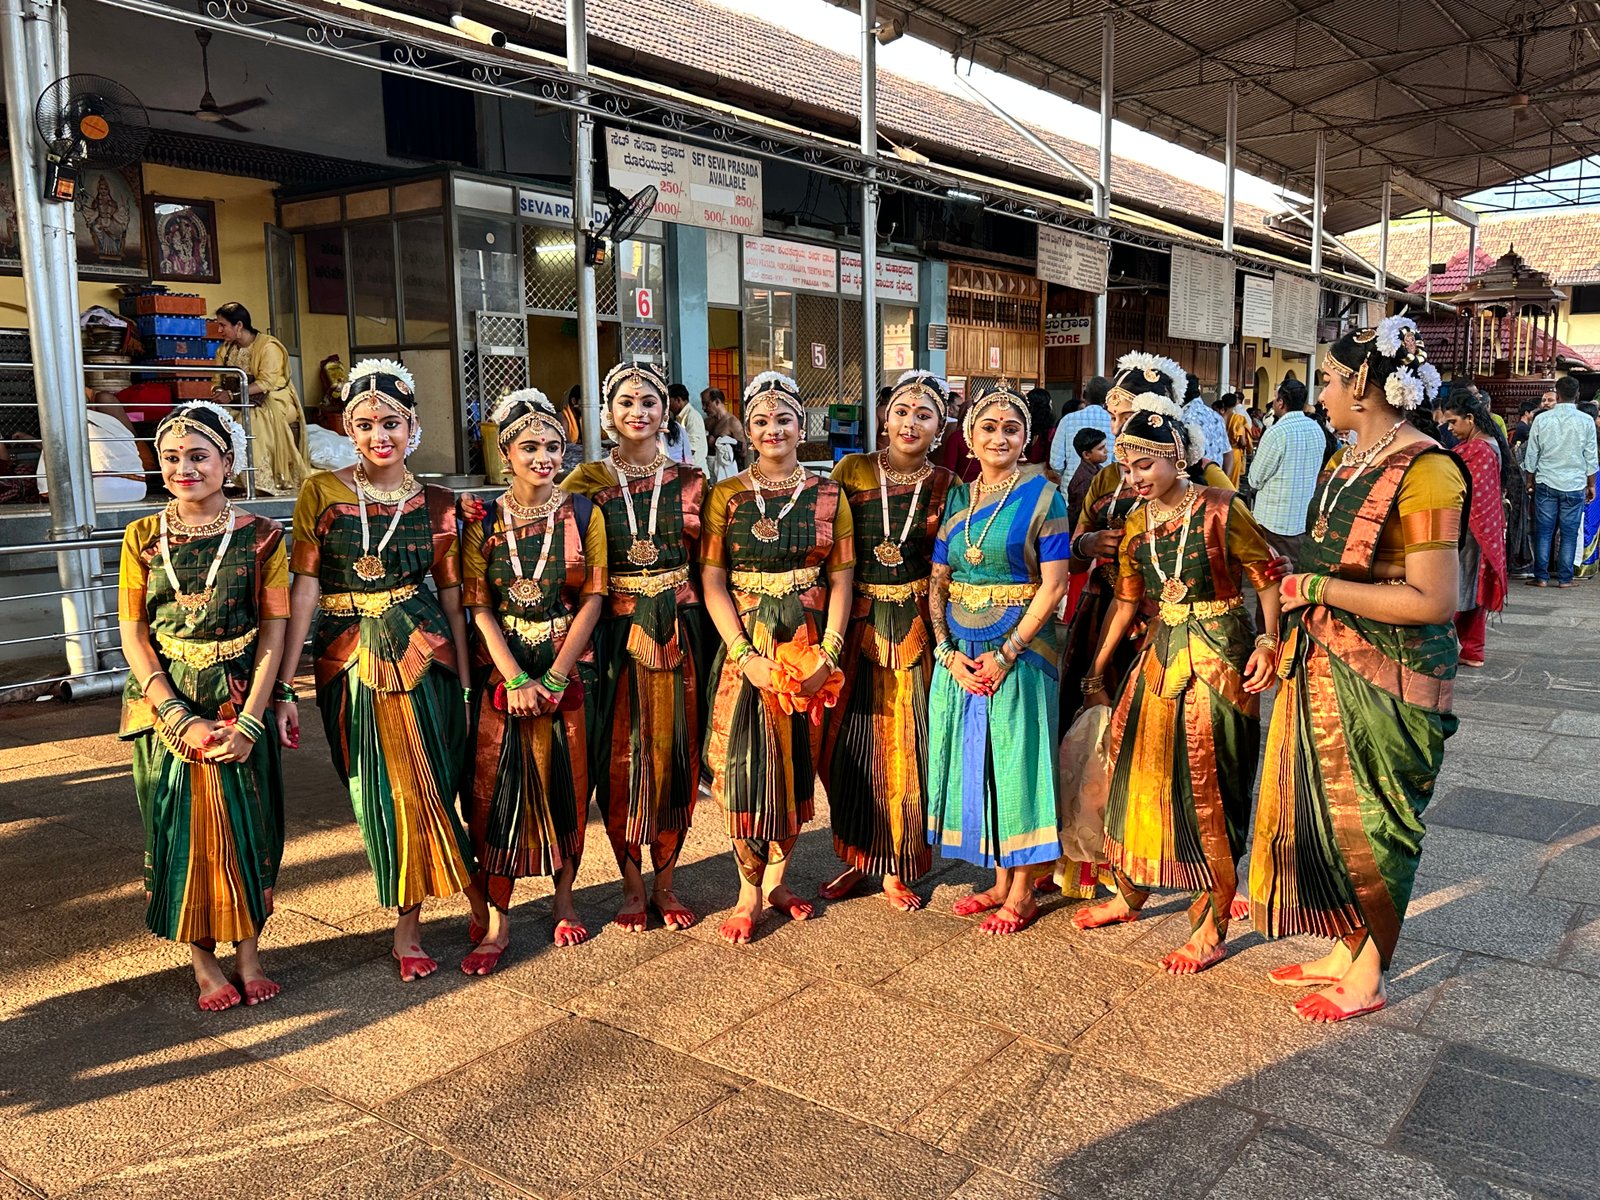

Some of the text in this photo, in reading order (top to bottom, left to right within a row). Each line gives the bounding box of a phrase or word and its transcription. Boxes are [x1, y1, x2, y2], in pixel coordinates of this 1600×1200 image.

[611, 132, 685, 159] ಸೆಟ್ ಸೇವಾ ಪ್ರಸಾದ
[692, 151, 758, 178] SET SEVA PRASADA
[709, 171, 746, 190] AVAILABLE
[520, 198, 553, 216] SEVA
[638, 289, 650, 317] 6
[1045, 335, 1080, 344] STORE
[814, 346, 823, 367] 5
[896, 347, 905, 367] 5
[992, 348, 998, 366] 4
